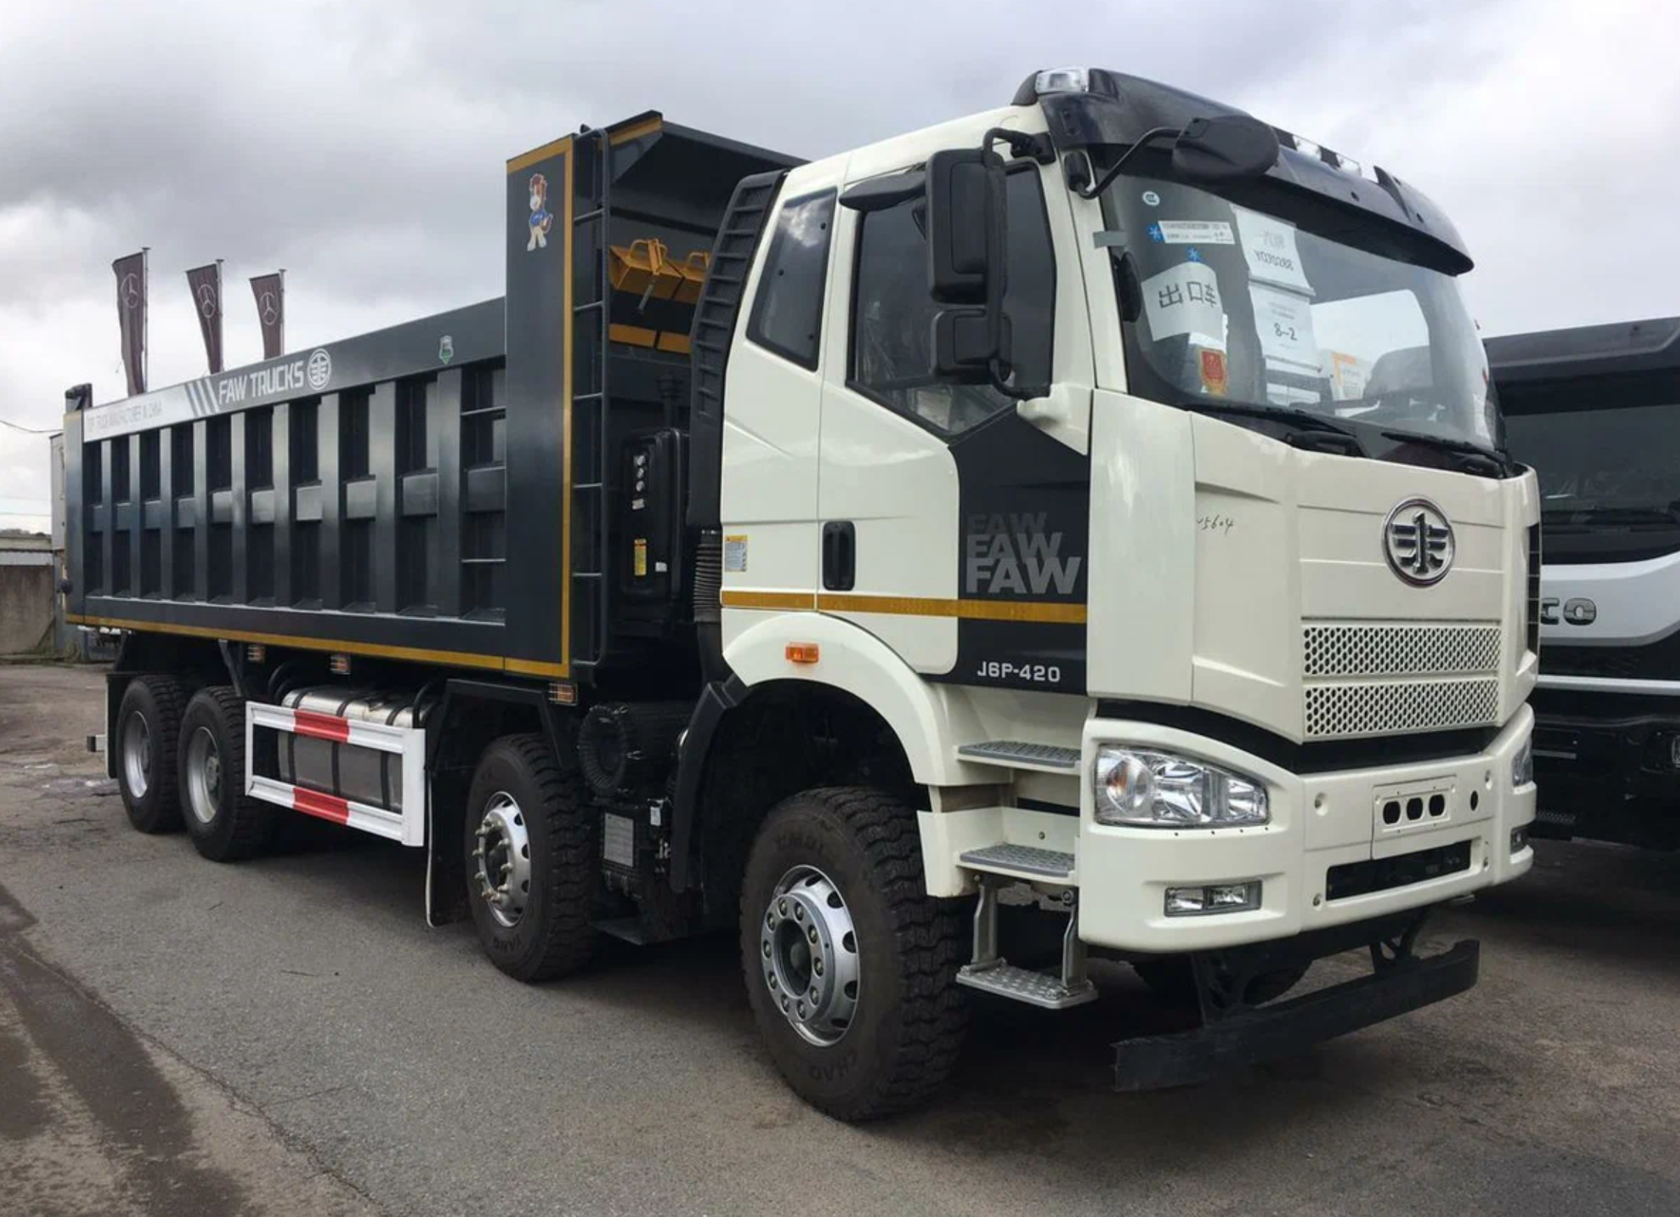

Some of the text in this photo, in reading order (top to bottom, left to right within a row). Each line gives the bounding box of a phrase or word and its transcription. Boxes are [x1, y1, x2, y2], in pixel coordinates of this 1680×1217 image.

[218, 361, 305, 405] FAW TRUCKS
[966, 556, 1082, 594] FAW
[977, 661, 1061, 683] J6P-420
